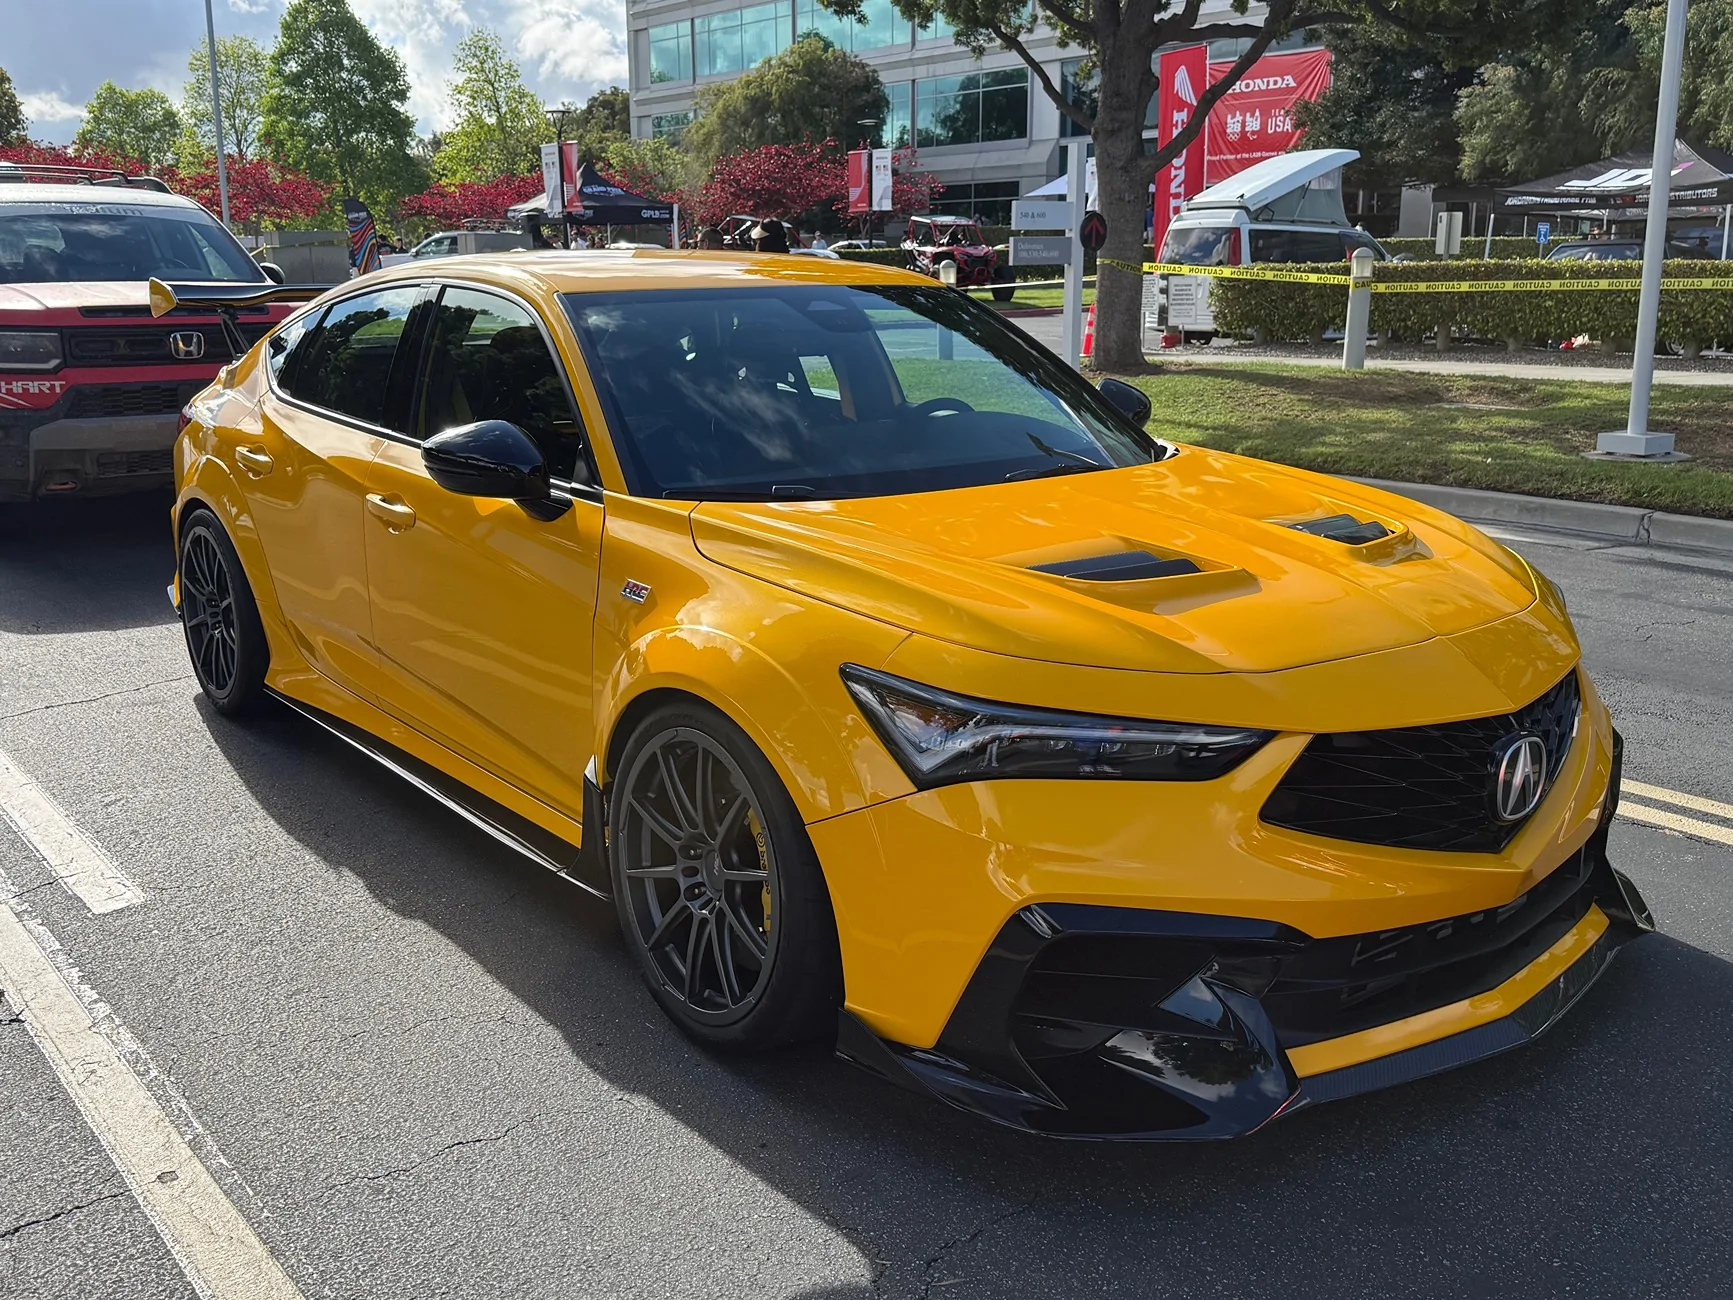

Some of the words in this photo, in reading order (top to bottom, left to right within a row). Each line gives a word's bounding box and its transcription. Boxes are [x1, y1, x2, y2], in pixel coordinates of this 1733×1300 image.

[1227, 75, 1297, 94] HONDA
[1267, 115, 1292, 134] USA
[0, 381, 66, 394] HART
